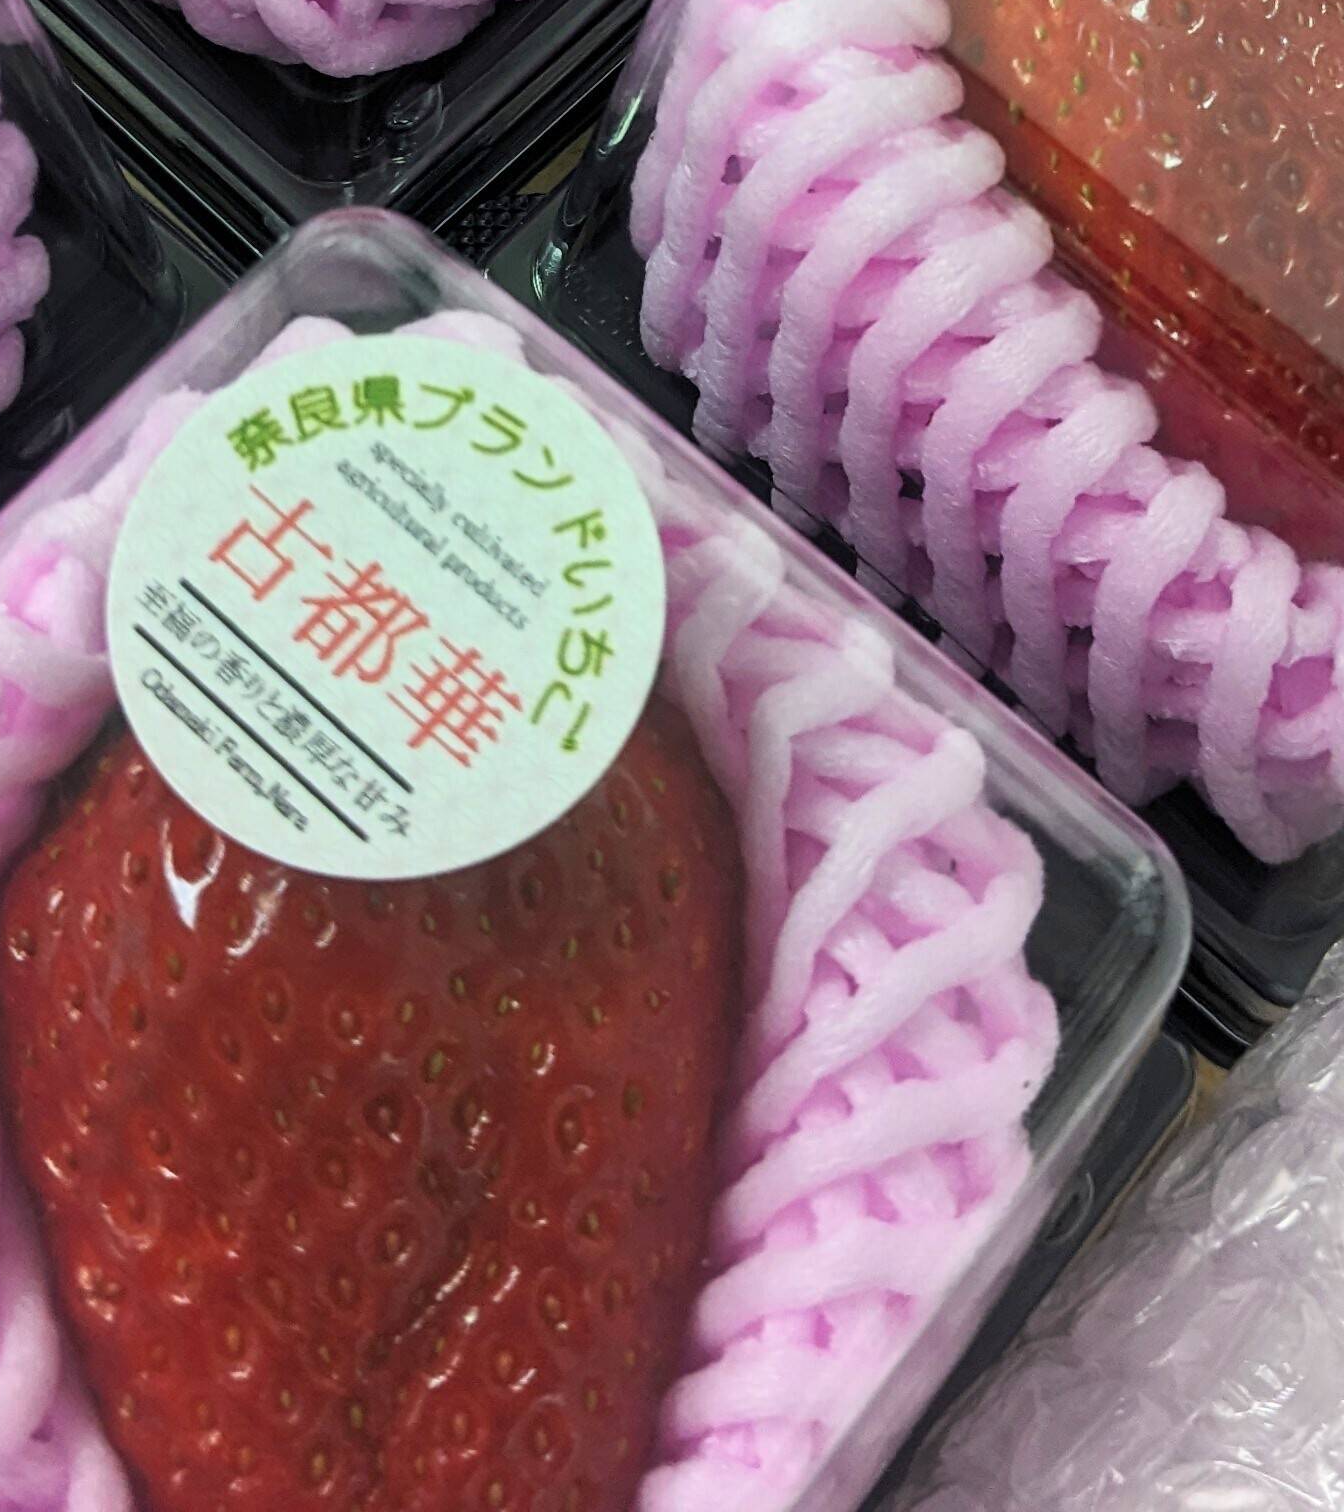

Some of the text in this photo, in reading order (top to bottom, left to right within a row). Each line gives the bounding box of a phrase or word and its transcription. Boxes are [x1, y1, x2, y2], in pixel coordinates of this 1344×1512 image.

[209, 485, 524, 769] 古都華
[227, 375, 615, 754] 奈良県ブランドいちご
[440, 550, 529, 630] products
[449, 505, 551, 598] cultivated
